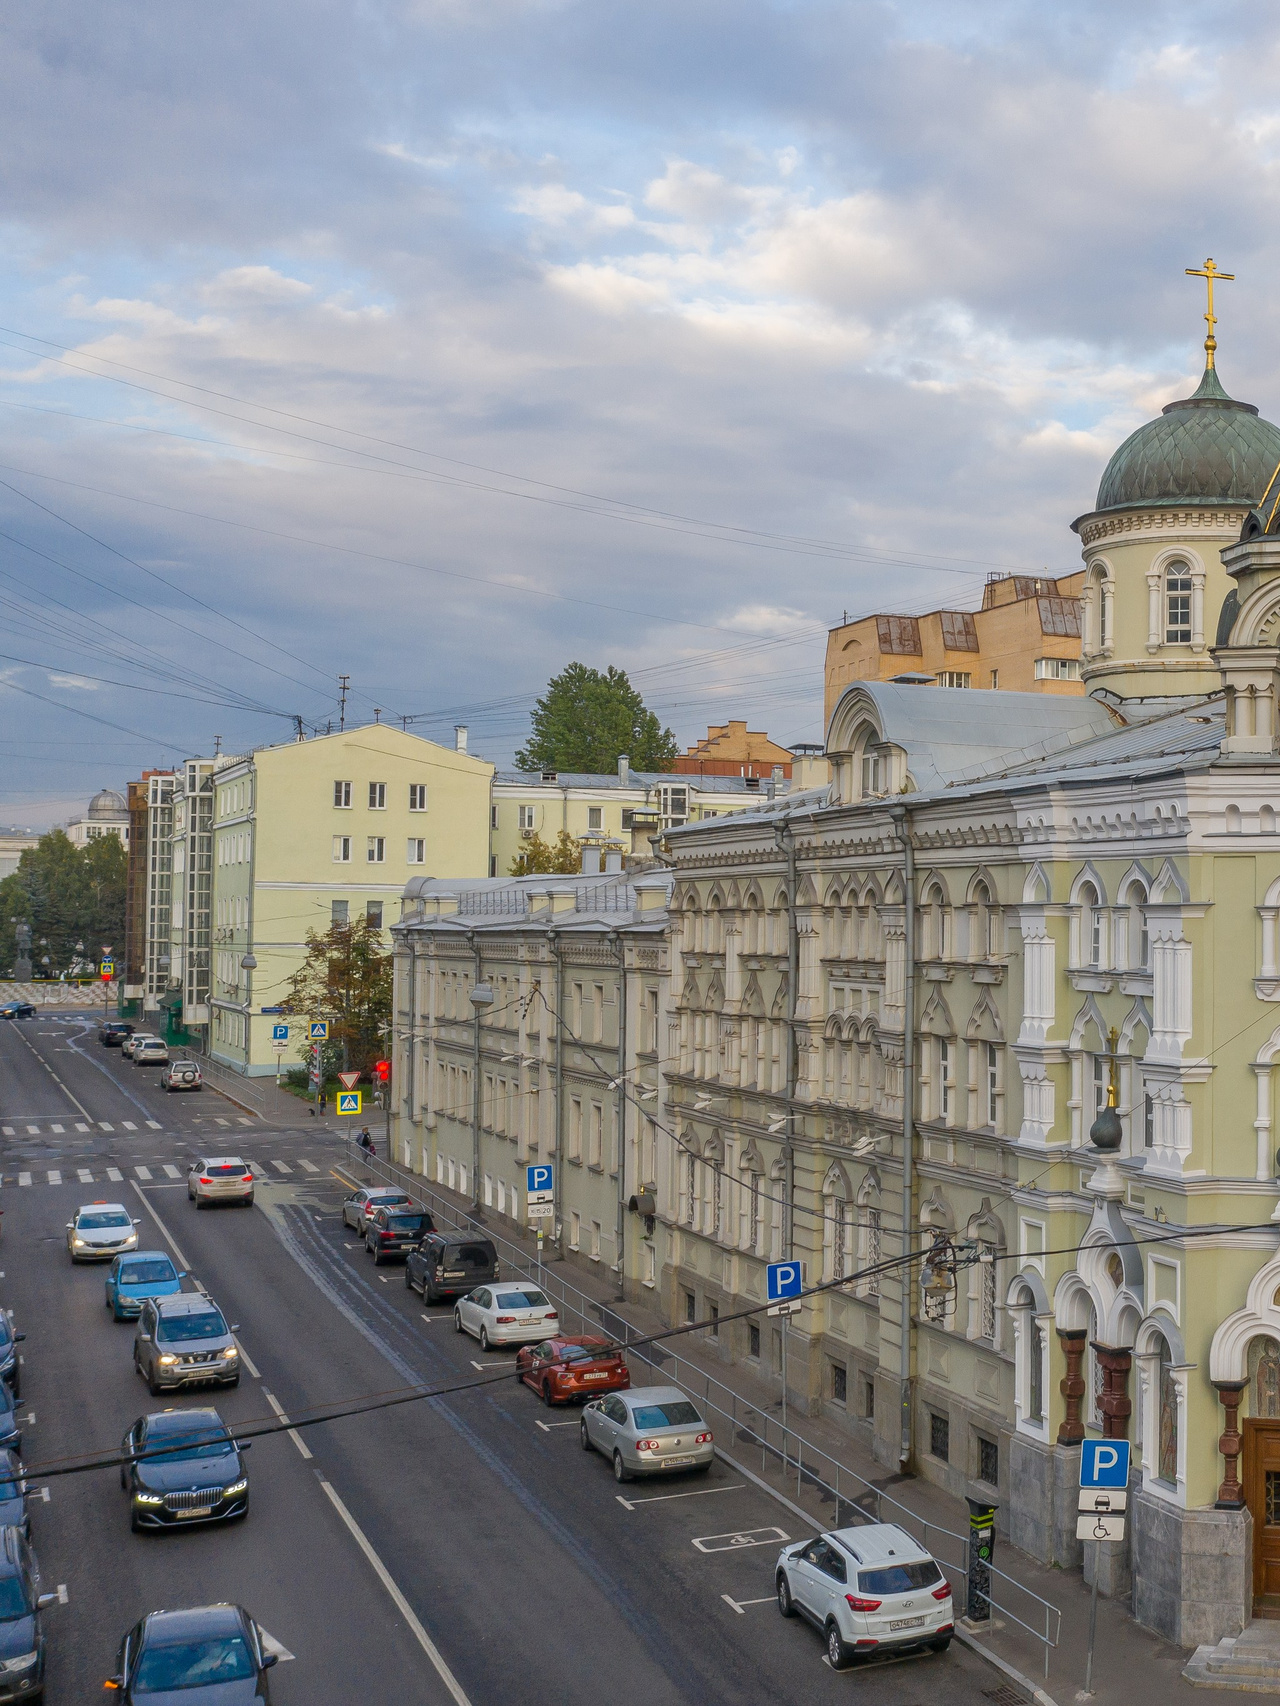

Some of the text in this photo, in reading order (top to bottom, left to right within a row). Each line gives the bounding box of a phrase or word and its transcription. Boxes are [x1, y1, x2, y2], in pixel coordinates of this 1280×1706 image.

[277, 1027, 285, 1038] P
[534, 1168, 548, 1189] P
[777, 1266, 795, 1295] P
[1093, 1446, 1118, 1481] P
